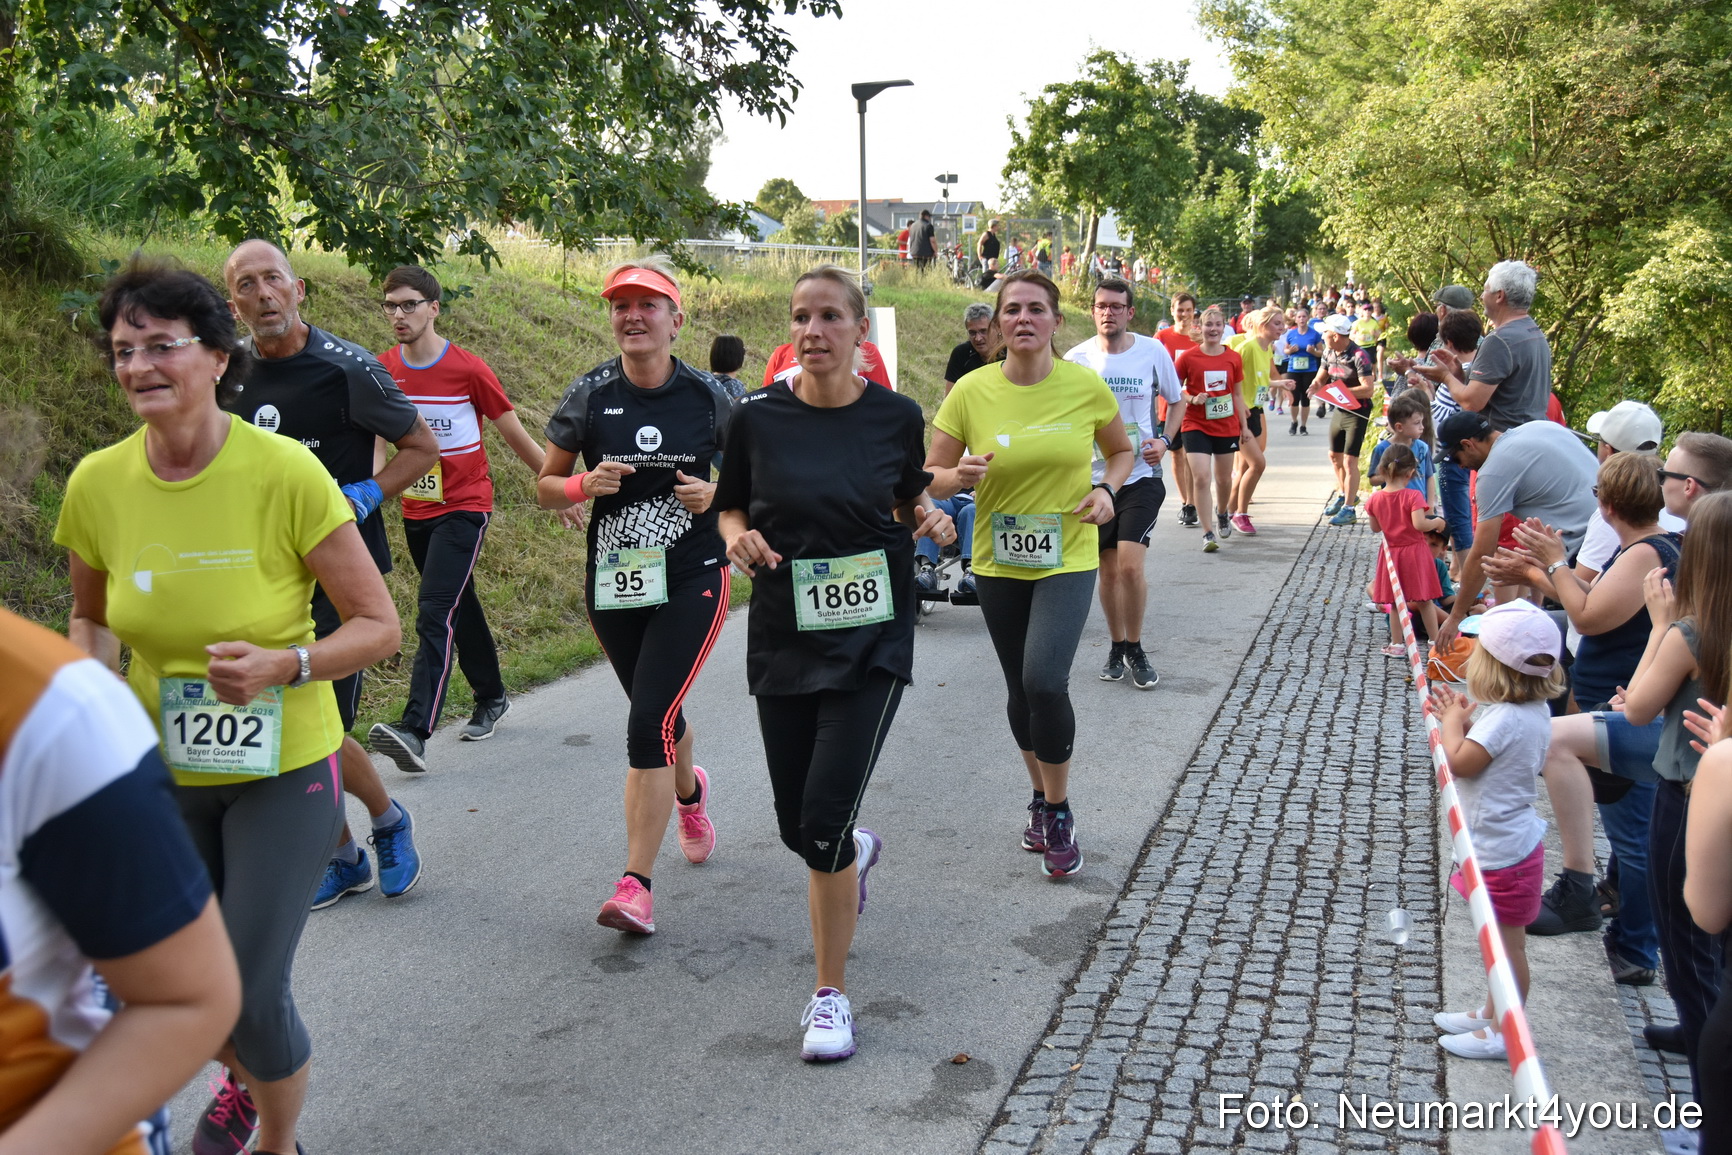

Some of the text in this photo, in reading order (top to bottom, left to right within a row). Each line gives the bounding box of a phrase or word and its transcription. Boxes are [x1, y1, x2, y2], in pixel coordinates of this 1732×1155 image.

[750, 393, 768, 401] JAKO
[1211, 402, 1229, 413] 498
[1000, 532, 1052, 553] 1304
[866, 569, 883, 578] 2019
[615, 570, 644, 592] 95
[807, 578, 879, 610] 1868
[817, 605, 873, 618] Subke Andreas
[843, 613, 867, 621] Neumarkt
[251, 707, 274, 716] 2019
[174, 712, 263, 748] 1202
[187, 747, 246, 758] Bayer Goretti
[213, 757, 244, 765] Neumarkt
